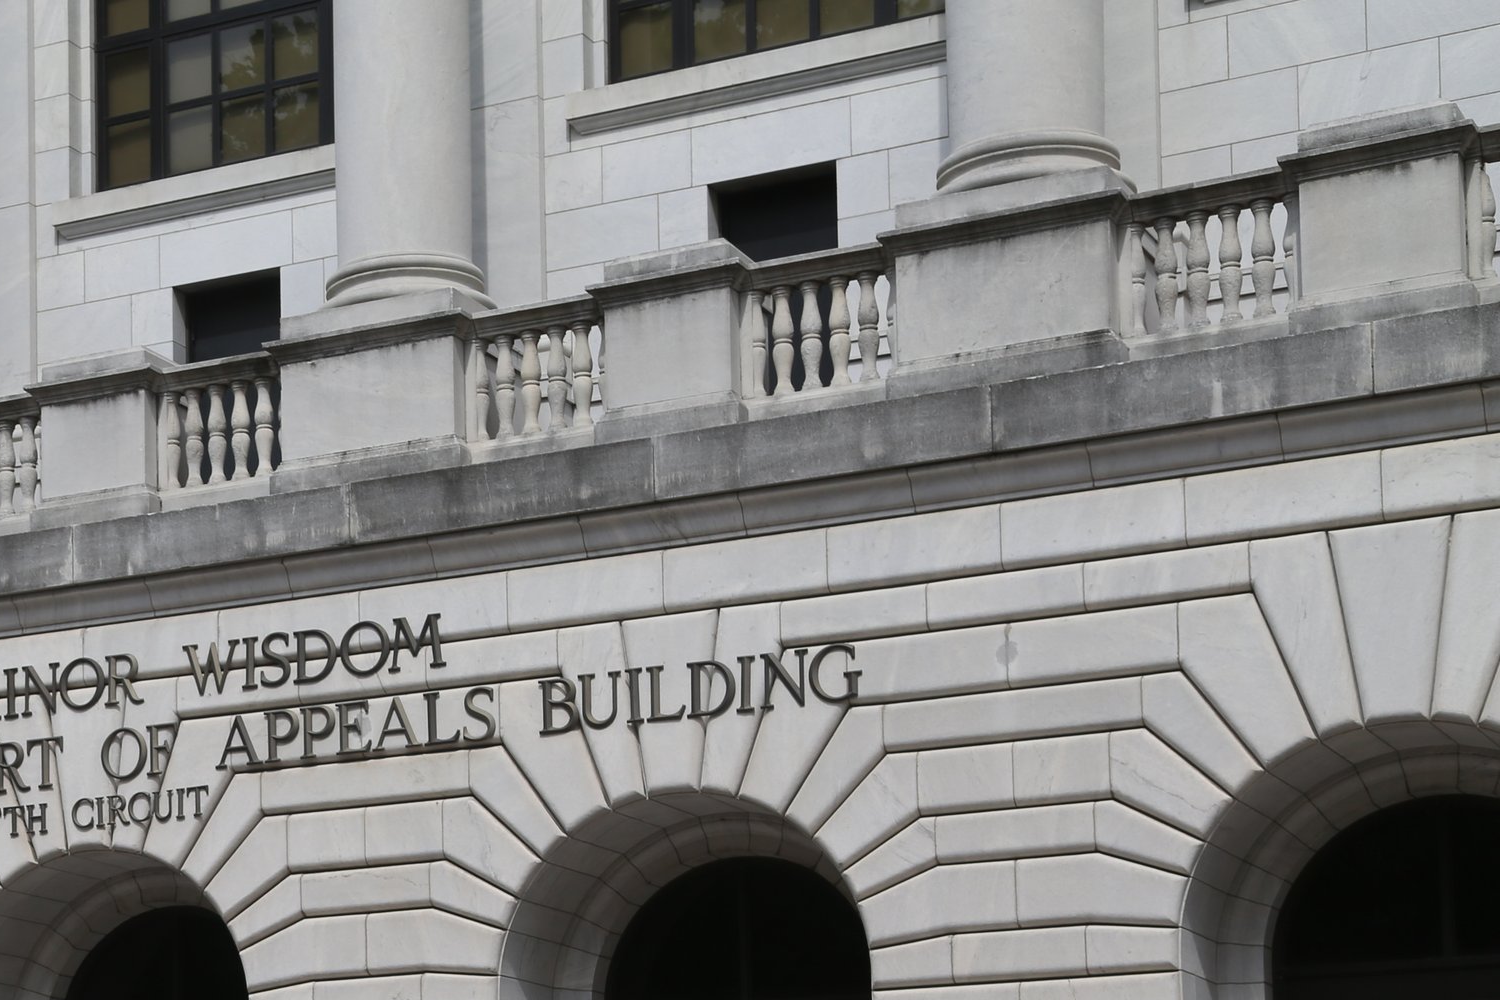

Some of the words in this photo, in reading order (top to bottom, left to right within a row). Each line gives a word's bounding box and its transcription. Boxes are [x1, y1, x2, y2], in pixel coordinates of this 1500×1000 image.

[182, 612, 448, 697] WISDOM
[100, 722, 178, 782] OF
[215, 686, 498, 770] APPEALS
[537, 643, 864, 738] BUILDING
[71, 785, 210, 830] CIRCUIT
